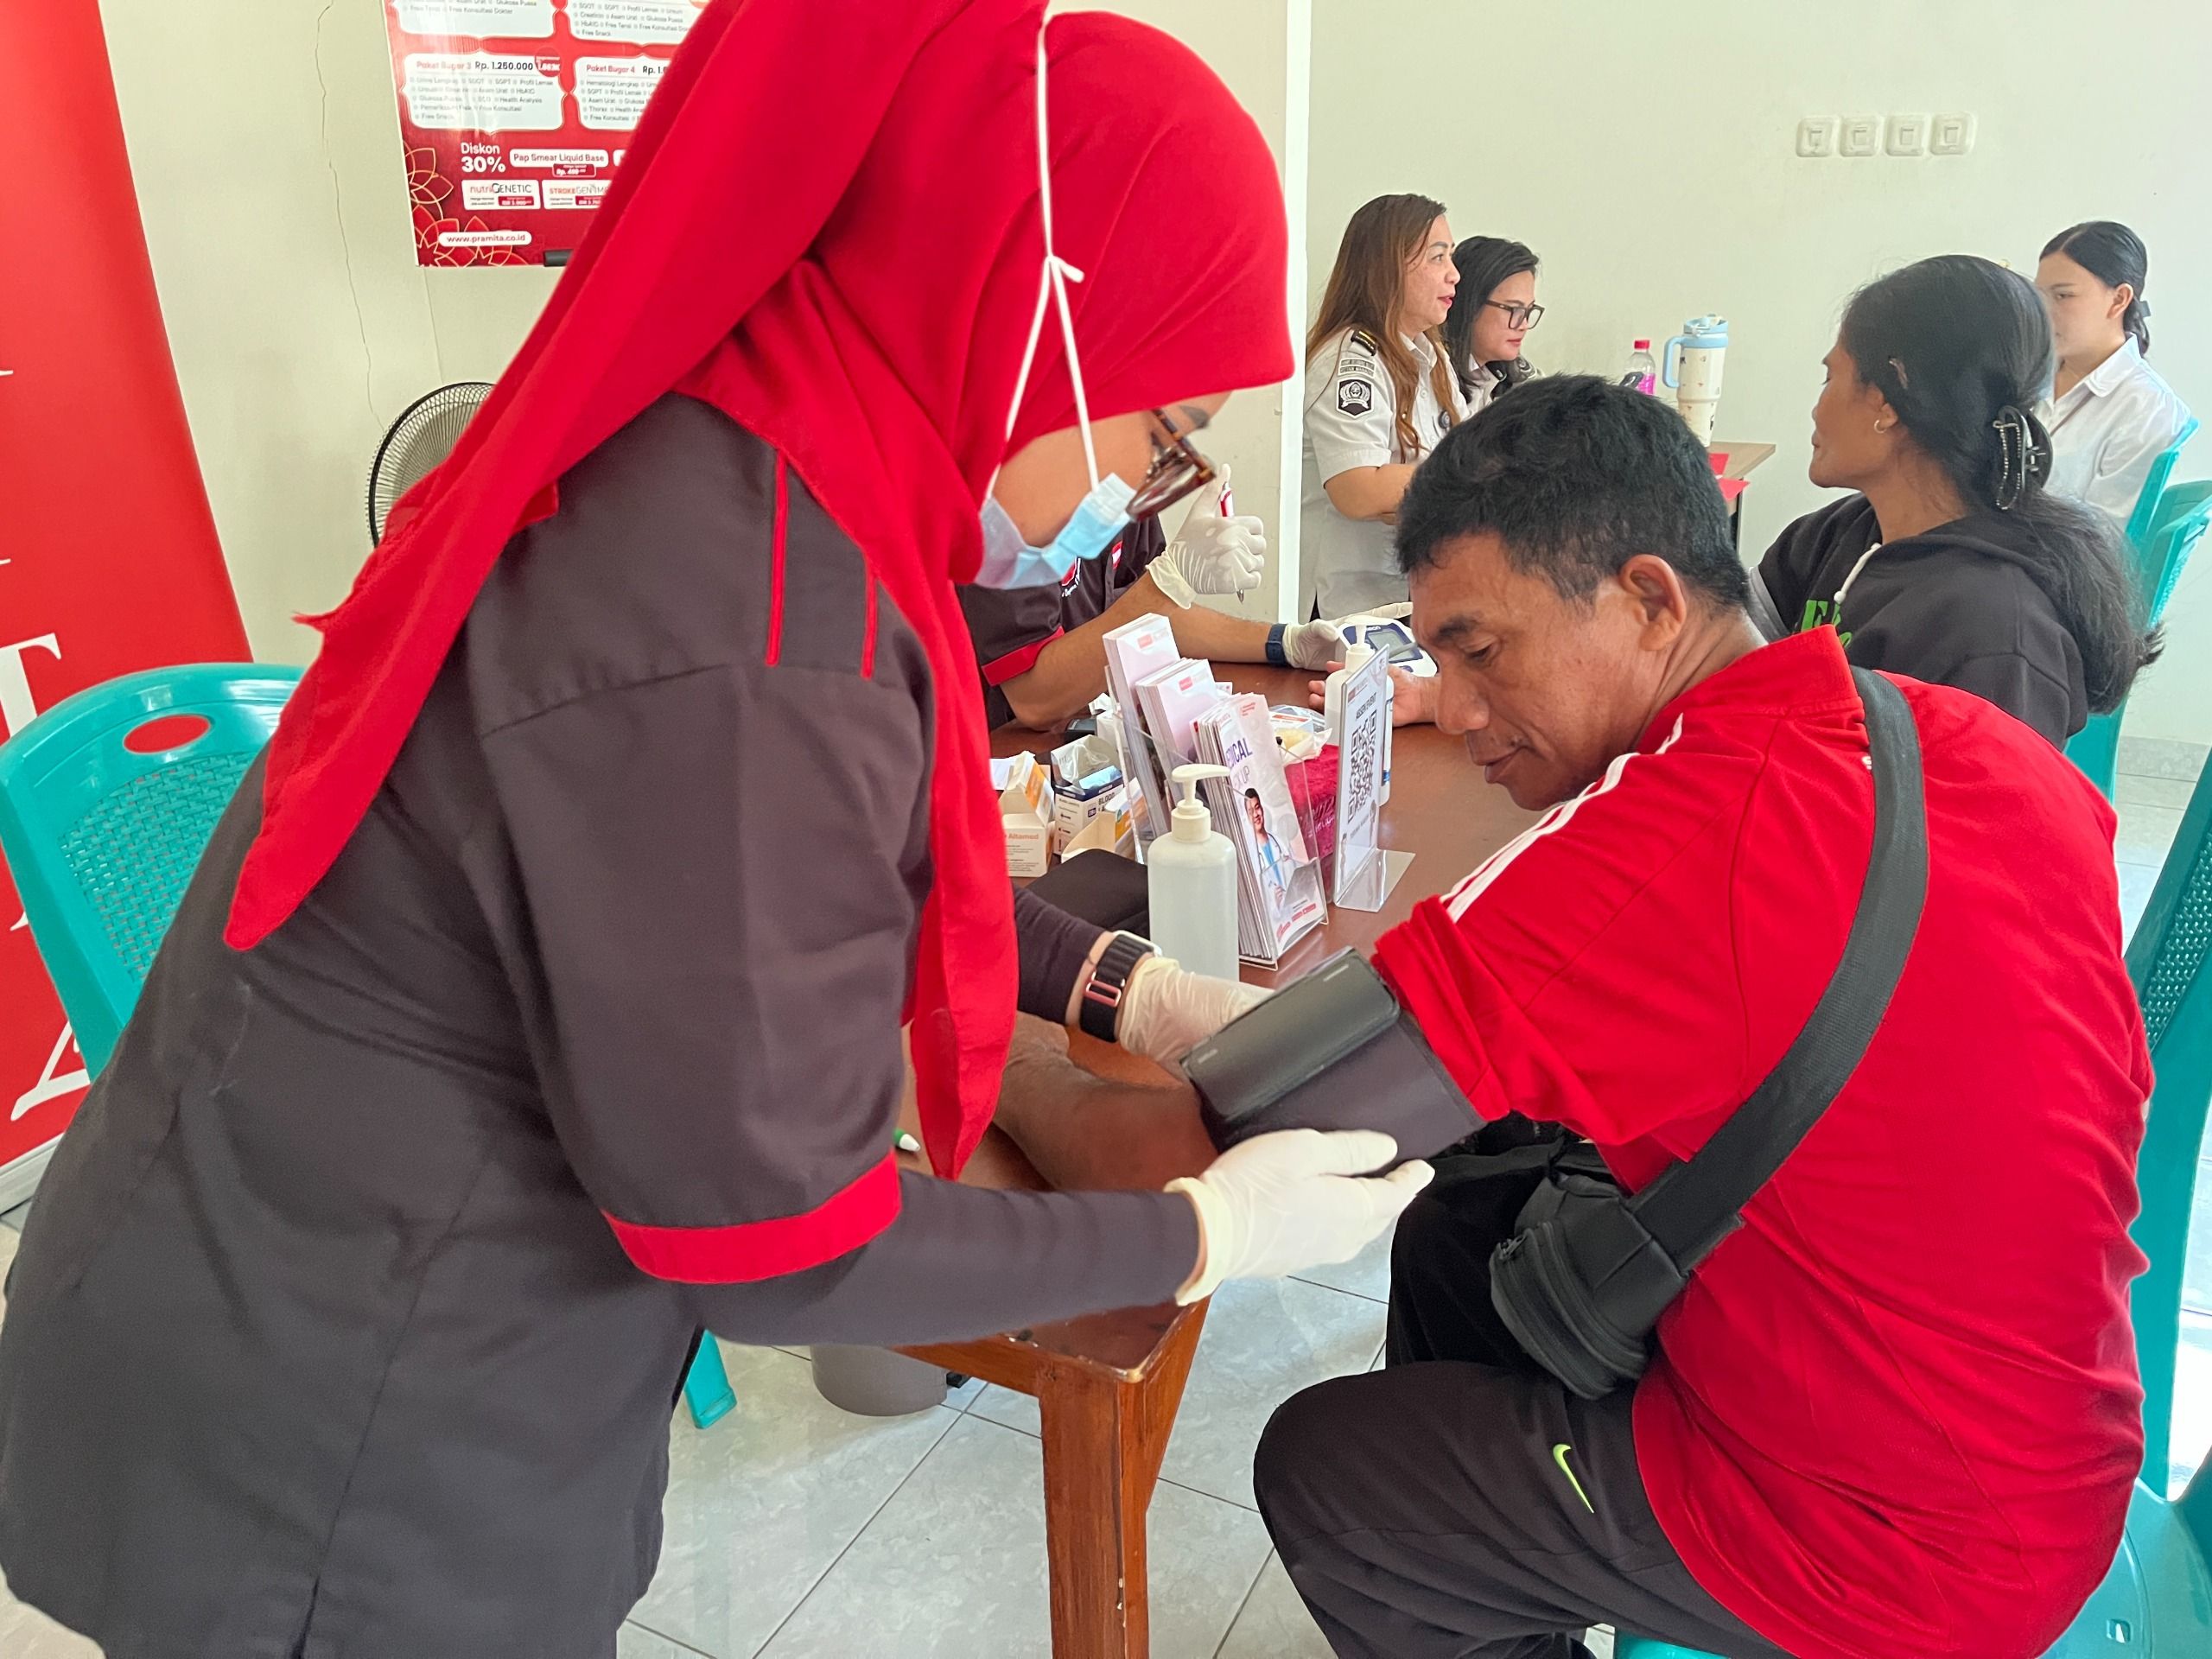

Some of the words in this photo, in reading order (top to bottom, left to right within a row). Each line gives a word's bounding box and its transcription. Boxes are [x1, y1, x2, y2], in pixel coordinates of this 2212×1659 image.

[474, 61, 489, 72] Rp.
[491, 61, 534, 71] 1.250.000
[586, 64, 607, 73] Paket
[607, 65, 630, 74] Bugar
[642, 66, 656, 75] Rp.
[461, 142, 500, 155] Diskon
[513, 153, 530, 162] Pap
[531, 153, 557, 162] Smear
[559, 153, 584, 163] Liquid
[585, 154, 605, 162] Base
[461, 156, 506, 173] 30%
[470, 182, 532, 194] nutriGENETIC
[447, 234, 526, 244] www.pramita.co.id
